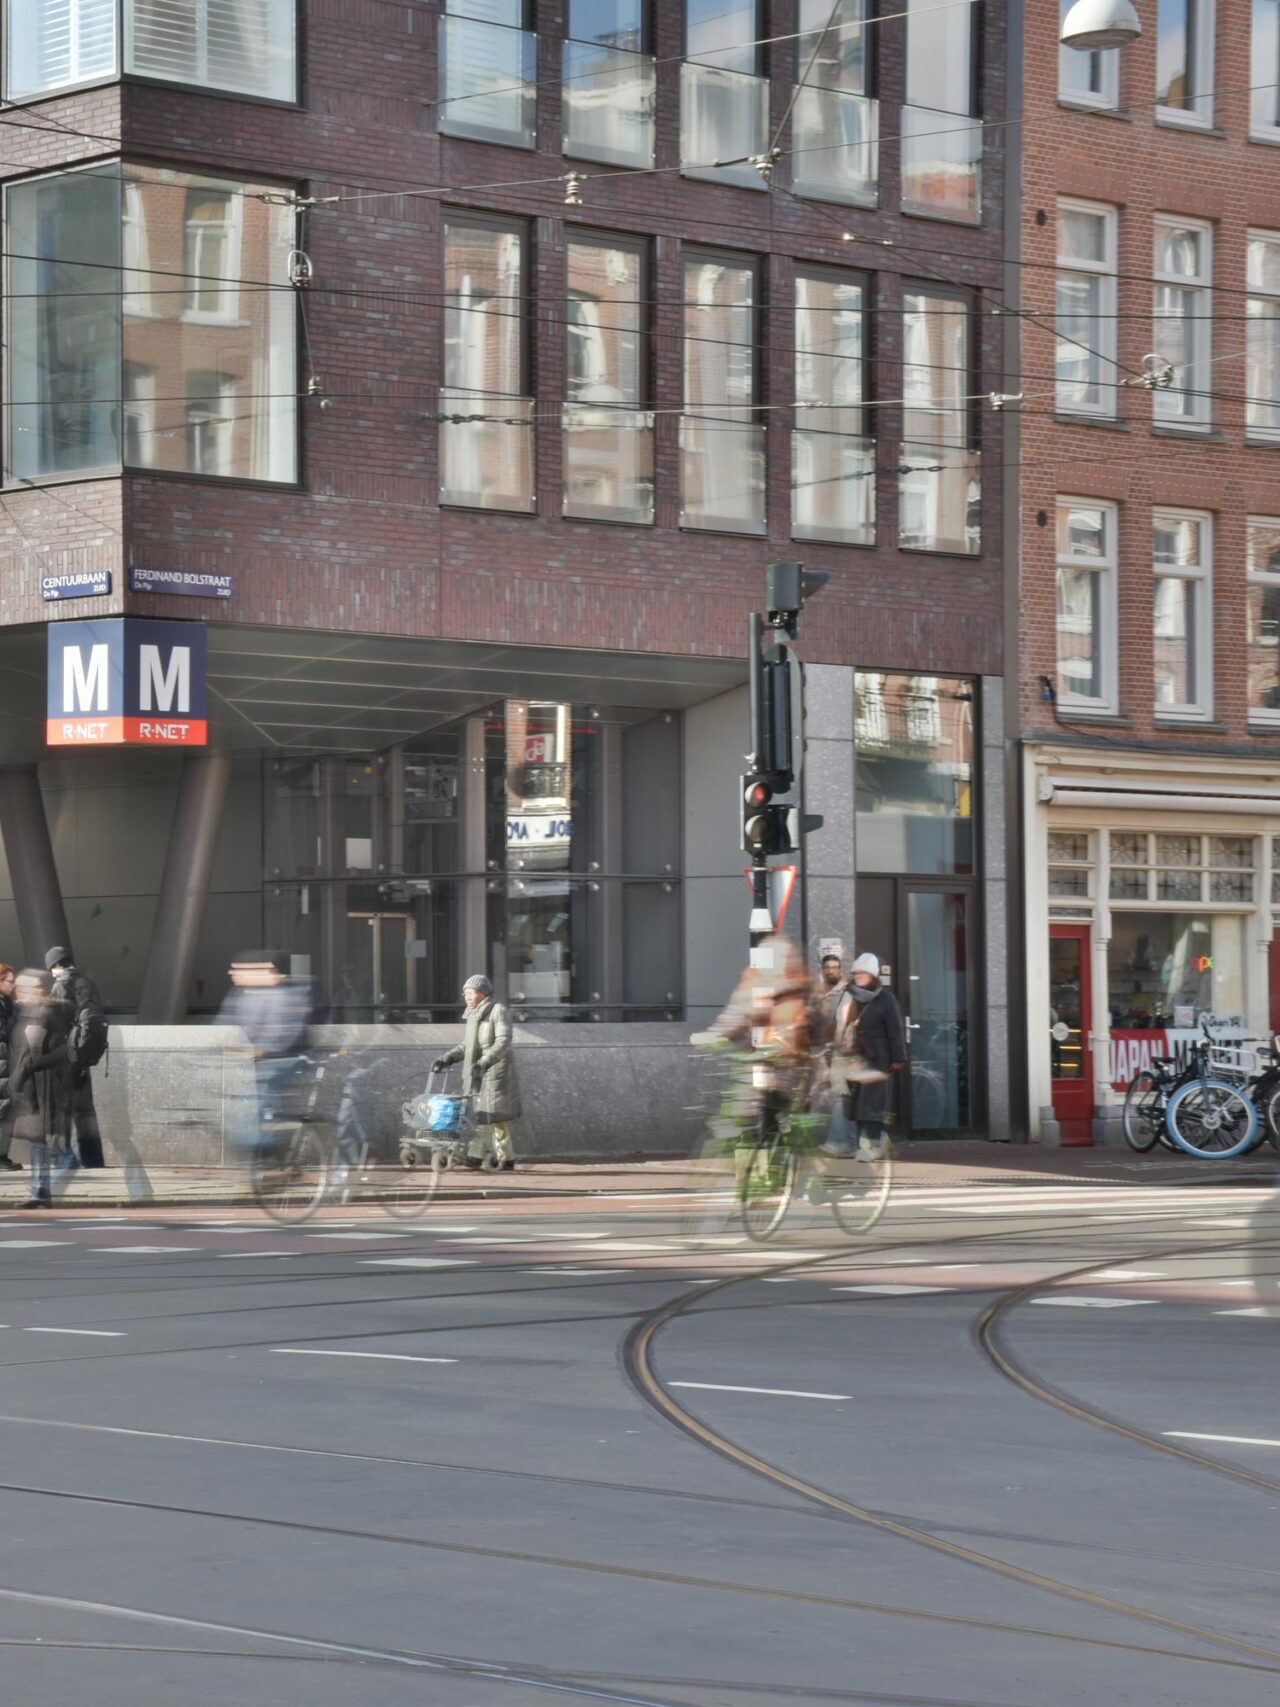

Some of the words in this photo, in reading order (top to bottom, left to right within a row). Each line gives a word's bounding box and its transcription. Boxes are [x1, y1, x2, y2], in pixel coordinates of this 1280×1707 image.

[43, 572, 106, 589] CEINTUURBAAN
[134, 569, 182, 584] FERDINAND
[183, 573, 232, 587] BOLSTRAAT
[63, 643, 108, 712] M
[139, 643, 190, 712] M
